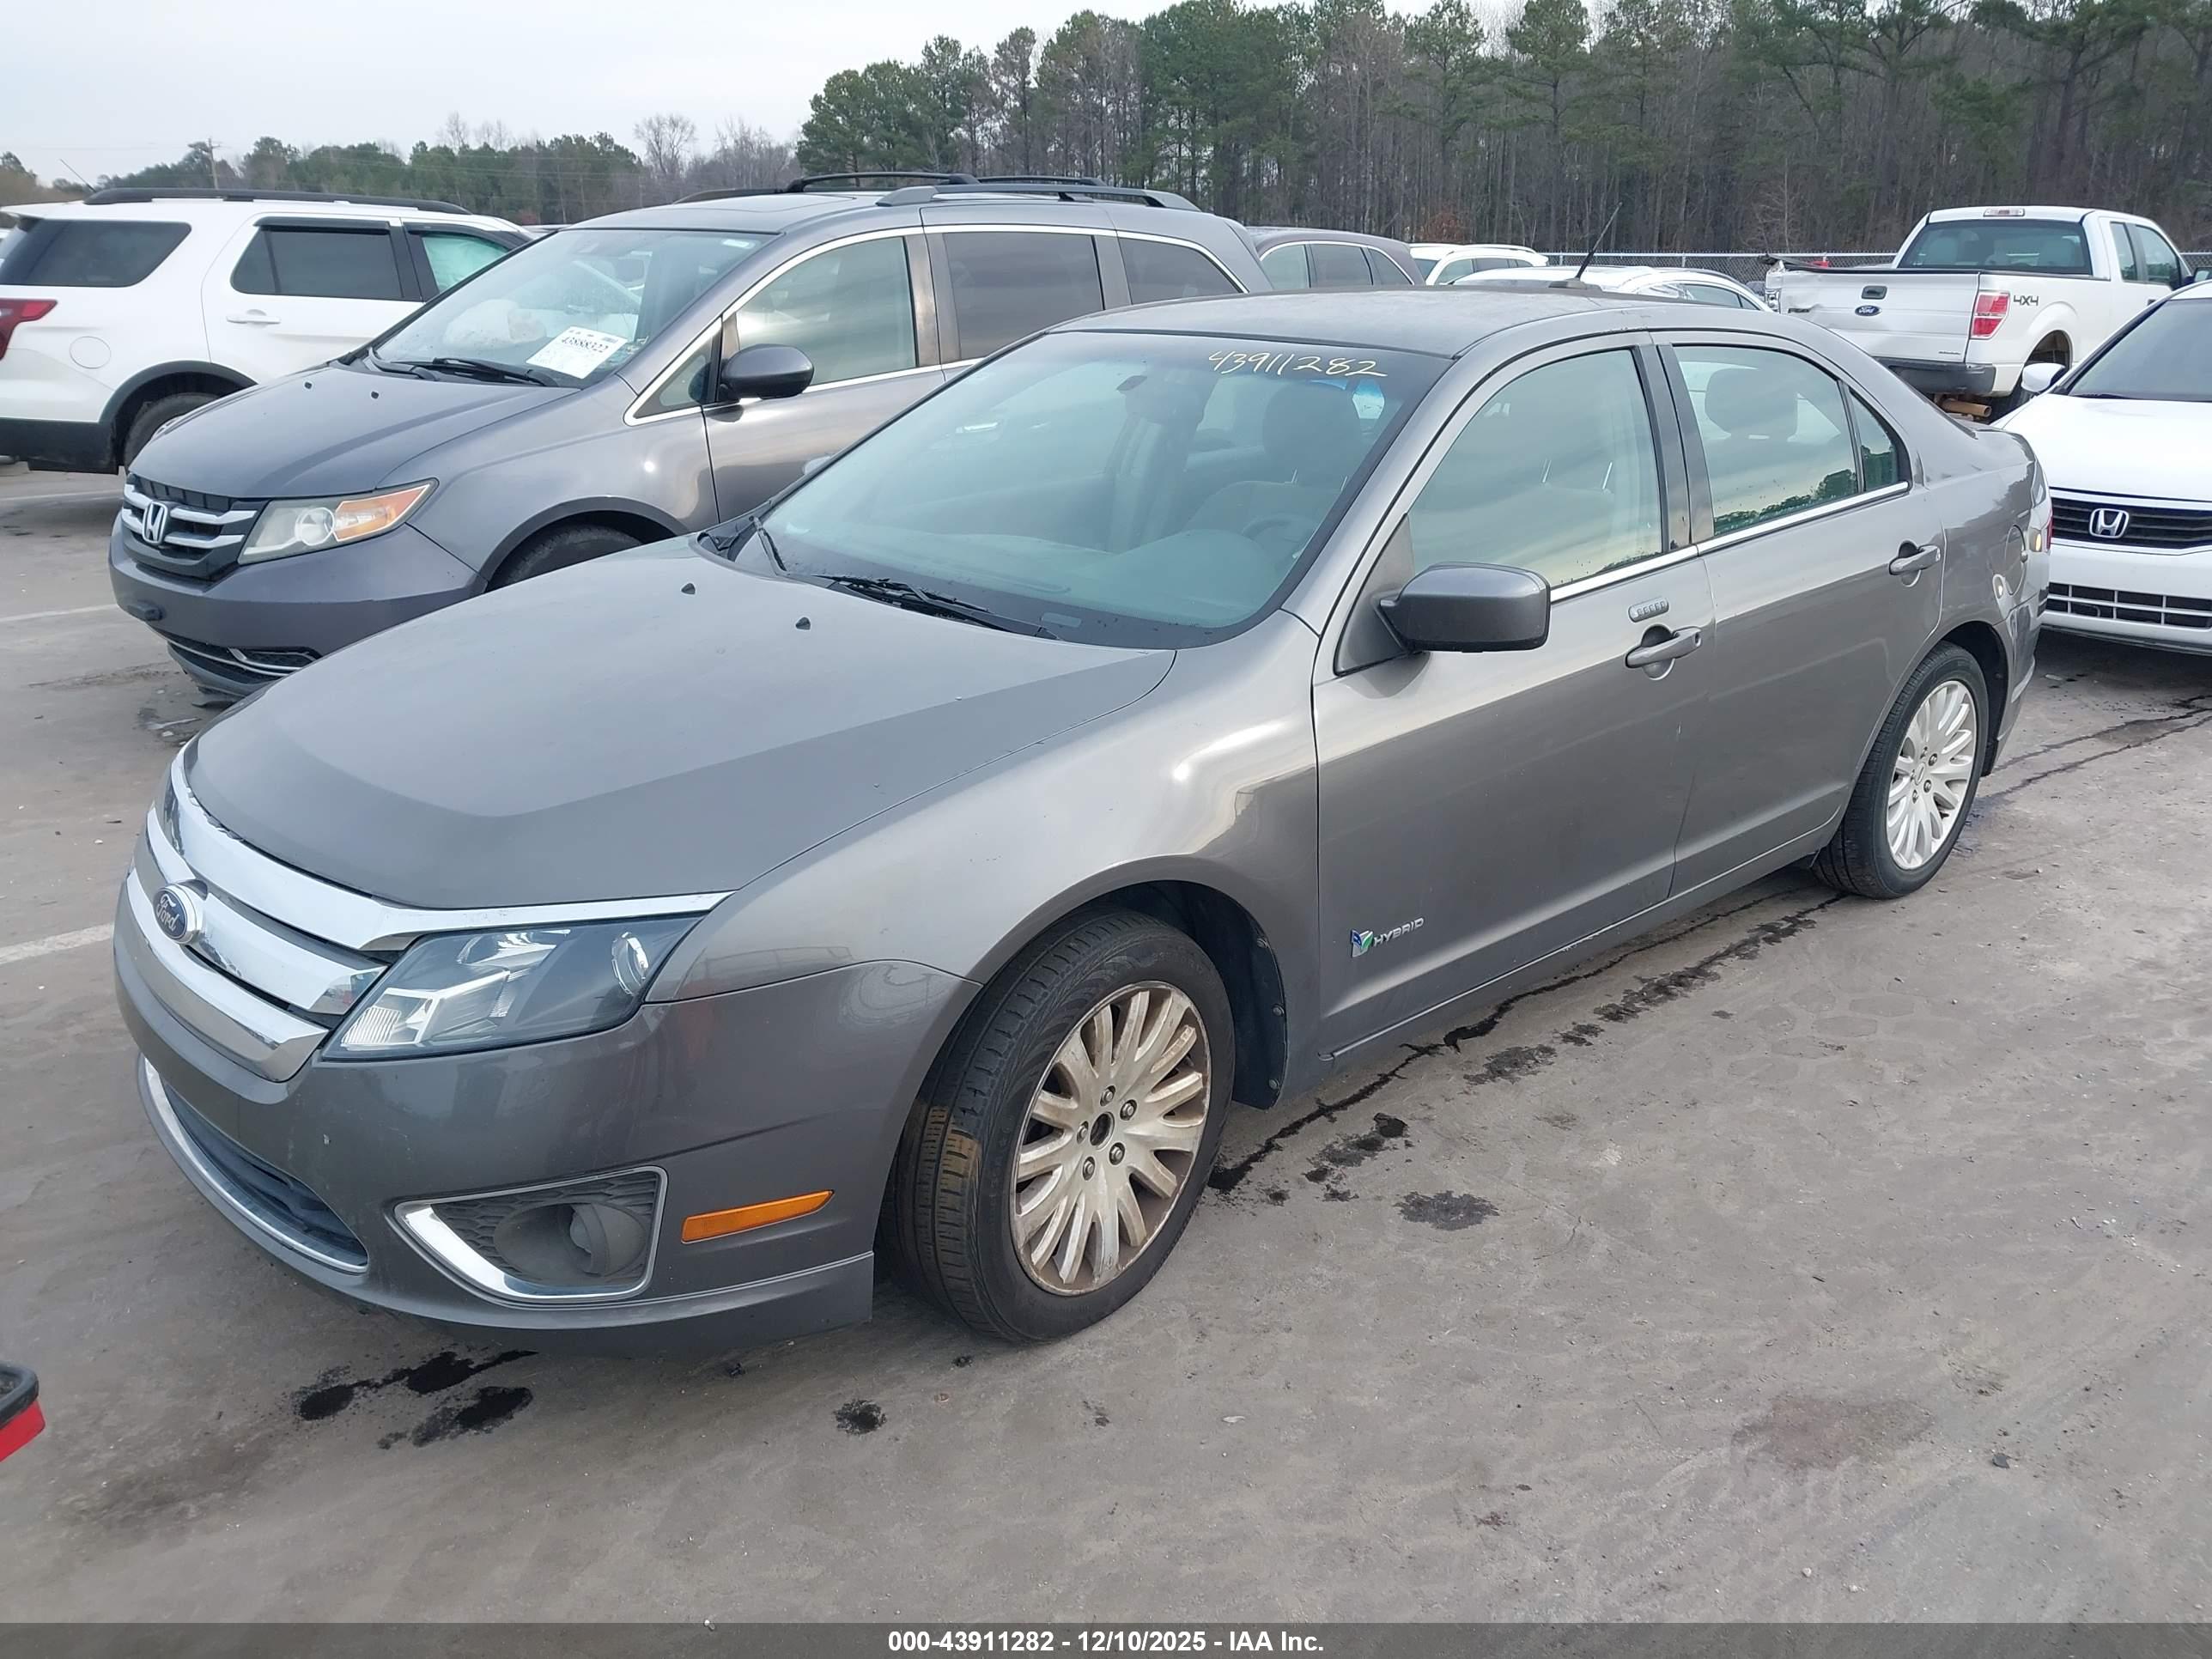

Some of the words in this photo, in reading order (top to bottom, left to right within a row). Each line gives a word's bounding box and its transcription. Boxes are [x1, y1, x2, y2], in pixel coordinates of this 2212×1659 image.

[1208, 350, 1388, 376] 43911282
[155, 893, 180, 932] Ford
[1374, 917, 1425, 947] HYBRID
